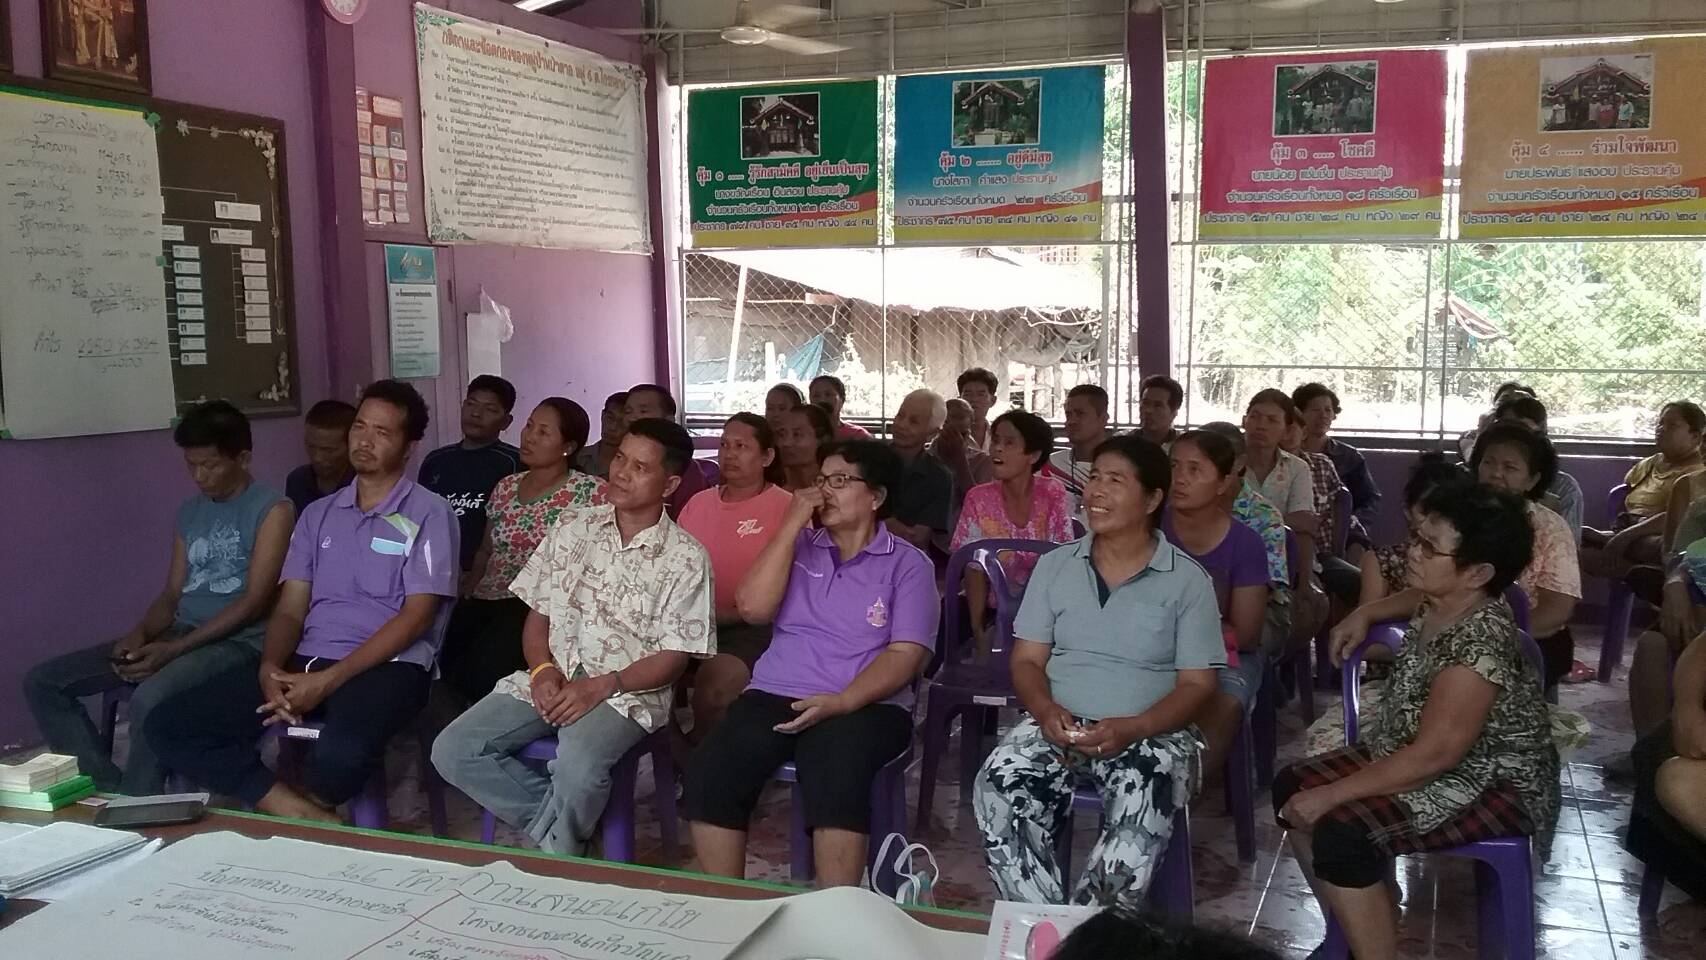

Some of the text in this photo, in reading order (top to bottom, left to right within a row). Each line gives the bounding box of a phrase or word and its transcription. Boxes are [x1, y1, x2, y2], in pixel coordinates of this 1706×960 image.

[1271, 142, 1290, 165] คุ้ม
[1295, 148, 1307, 159] ๓
[1340, 139, 1376, 158] โชคดี
[1511, 141, 1530, 162] คุ้ม
[1538, 144, 1549, 156] ๔
[1591, 135, 1678, 155] ร่วมใจพัฒนา
[939, 151, 956, 173] คุ้ม
[960, 156, 971, 167] ๒
[697, 167, 711, 186] คุ้ม
[715, 171, 723, 181] ๑
[907, 193, 1005, 207] จำนวนครัวเรือนทั้งหมด
[1043, 190, 1087, 204] ครัวเรือน
[1226, 185, 1342, 203] จำนวนครัวเรือนทั้งหมด
[1368, 187, 1419, 200] ครัวเรือน
[1487, 185, 1615, 202] จำนวนครัวเรือนทั้งหมด
[1644, 186, 1699, 200] ครัวเรือน
[820, 199, 860, 213] ครัวเรือน
[897, 215, 933, 226] ประชากร
[959, 216, 972, 225] คน
[975, 215, 993, 225] ชาย
[1017, 215, 1031, 224] คน
[1083, 213, 1097, 223] คน
[1204, 211, 1246, 224] ประชากร
[1274, 212, 1290, 222] คน
[1295, 211, 1314, 222] ชาย
[1345, 211, 1361, 221] คน
[1366, 209, 1394, 222] หญิง
[1425, 211, 1441, 221] คน
[1463, 211, 1509, 225] ประชากร
[1539, 212, 1555, 223] คน
[1561, 212, 1584, 223] ชาย
[1617, 211, 1633, 222] คน
[1640, 209, 1669, 221] หญิง
[694, 220, 727, 231] ประชากร
